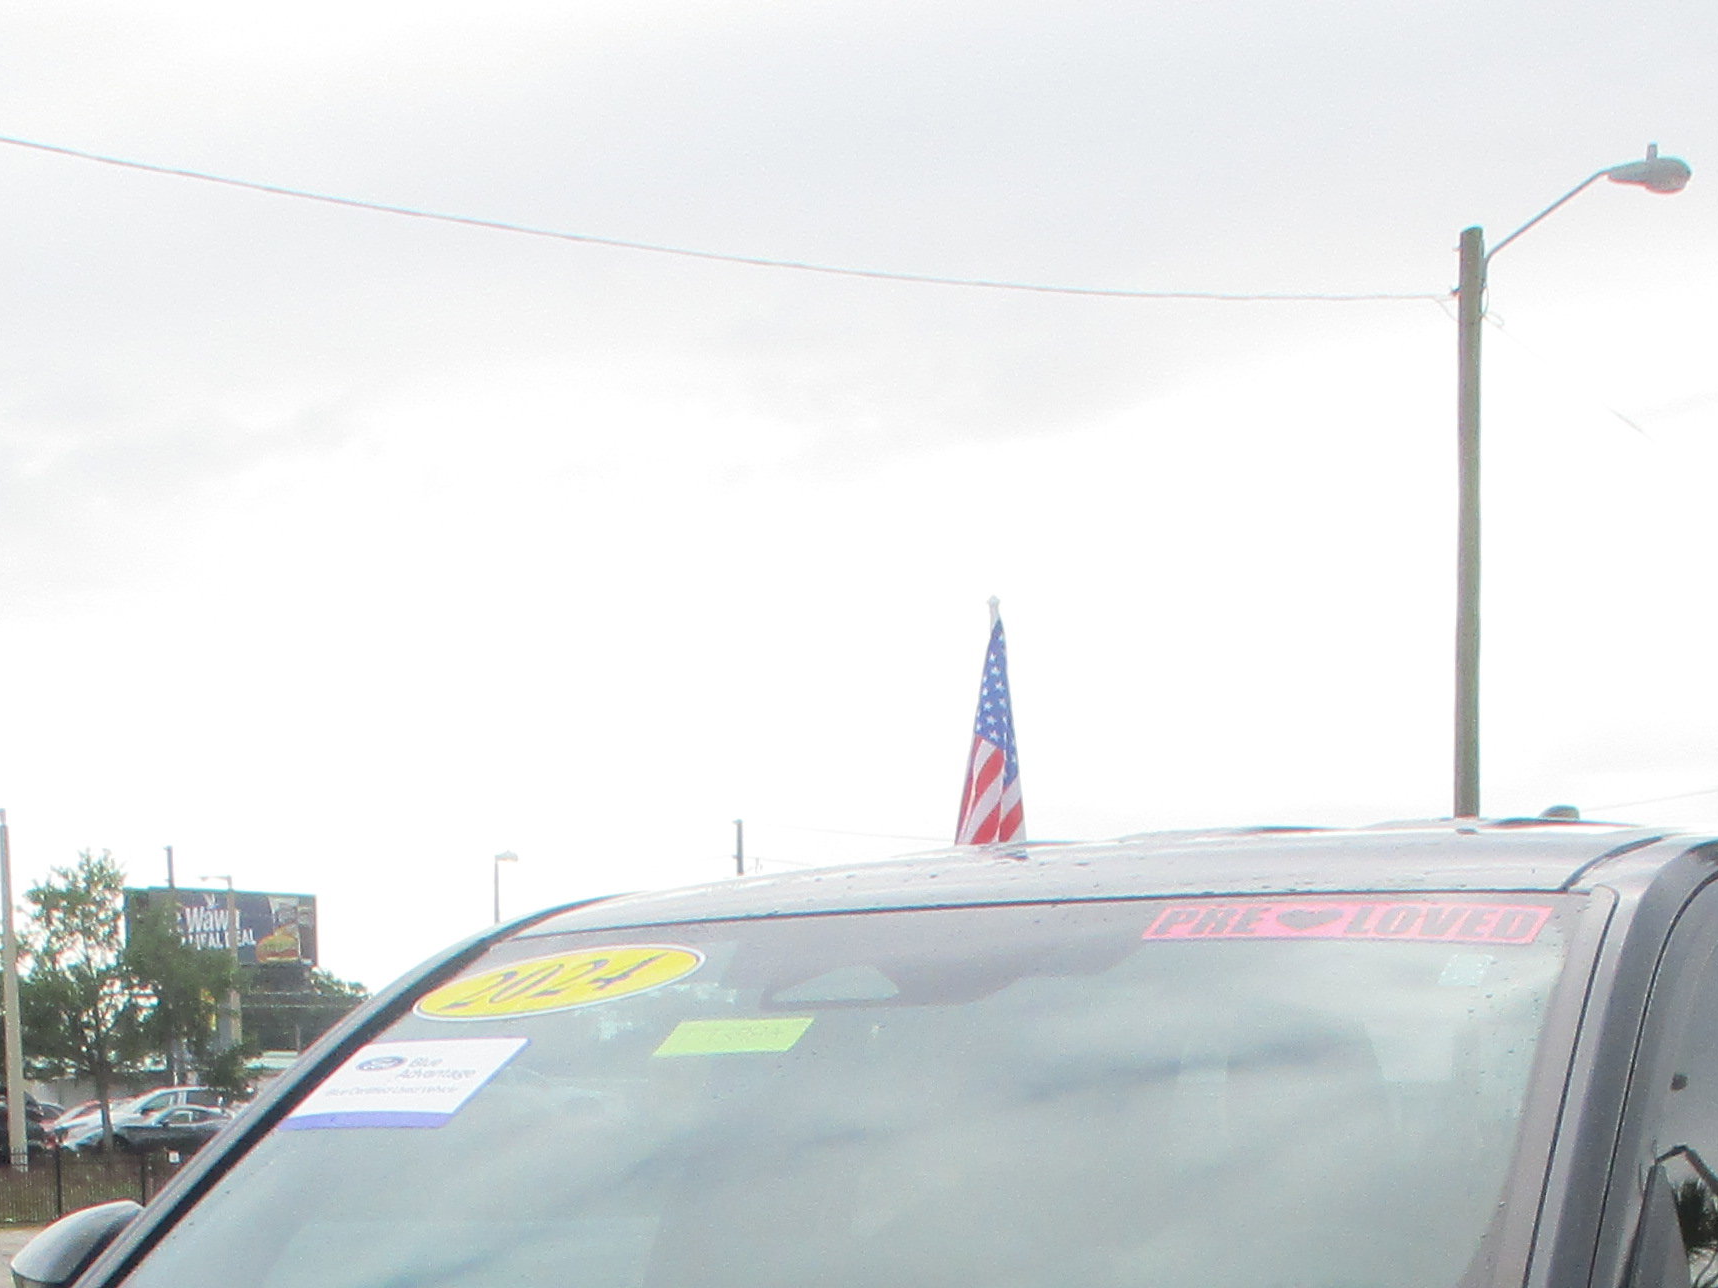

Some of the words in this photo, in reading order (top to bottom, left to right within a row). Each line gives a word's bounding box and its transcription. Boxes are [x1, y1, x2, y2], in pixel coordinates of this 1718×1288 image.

[1152, 907, 1273, 936] PRE
[1344, 903, 1543, 939] LOVED
[437, 951, 670, 1010] 2024
